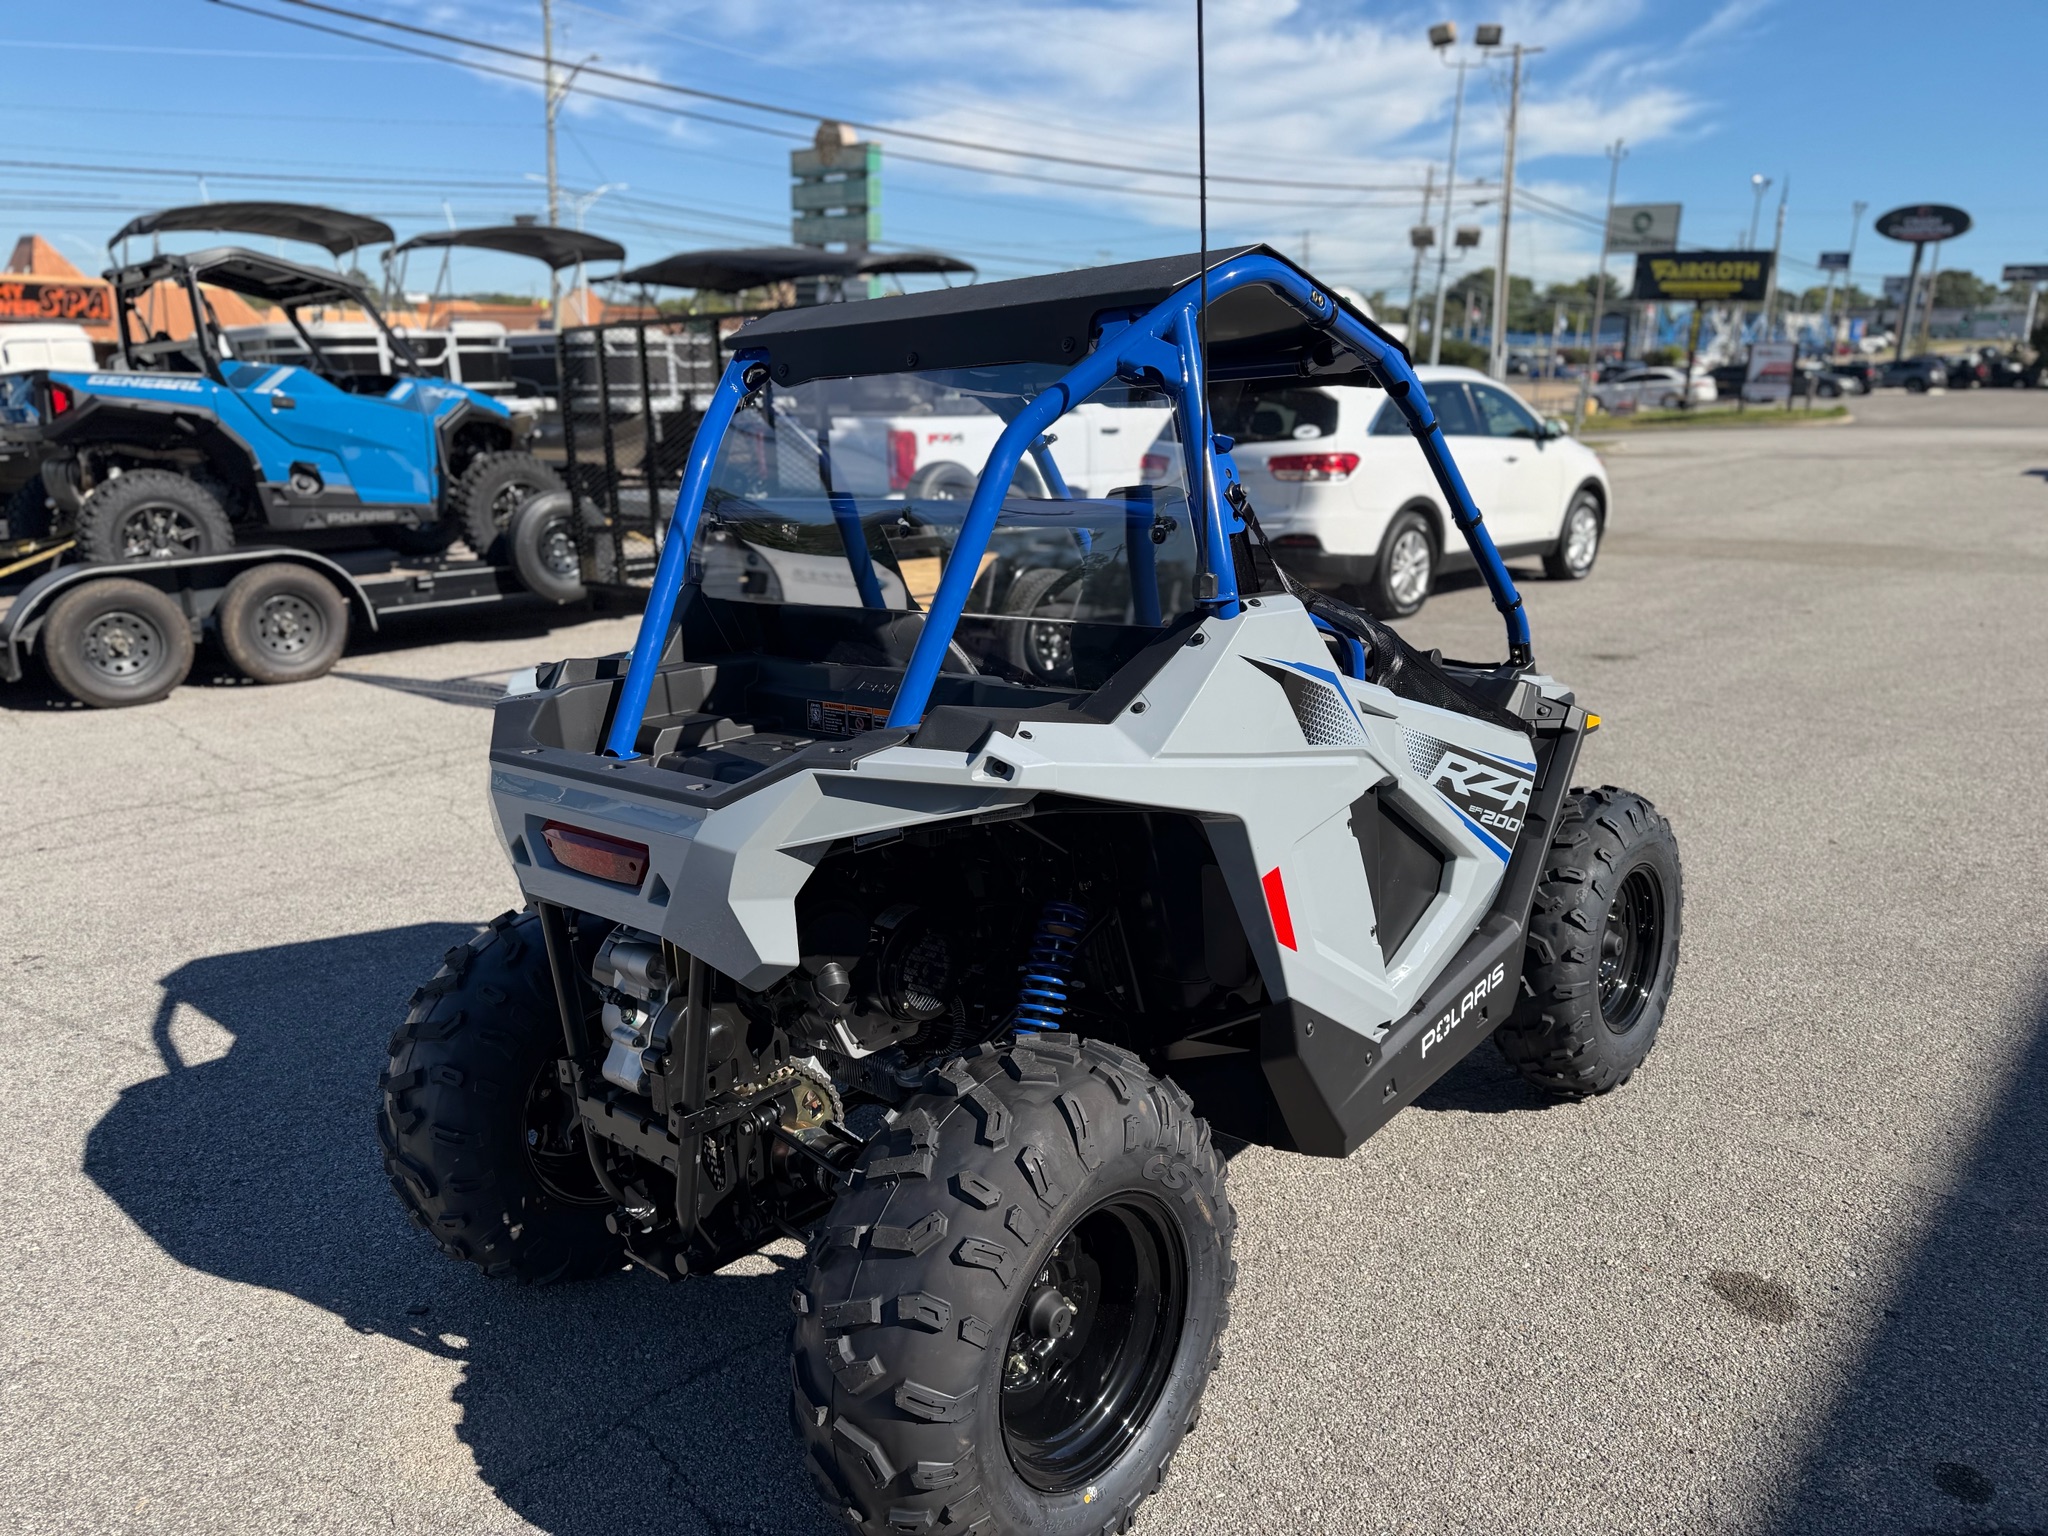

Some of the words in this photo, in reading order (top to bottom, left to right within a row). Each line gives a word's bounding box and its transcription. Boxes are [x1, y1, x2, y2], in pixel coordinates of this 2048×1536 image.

[1650, 259, 1761, 281] FAIRCLOTH
[39, 285, 111, 319] SPA
[86, 375, 204, 393] GENERAL
[927, 433, 964, 446] FX4
[1480, 809, 1521, 833] 200
[1421, 962, 1505, 1060] POLARIS
